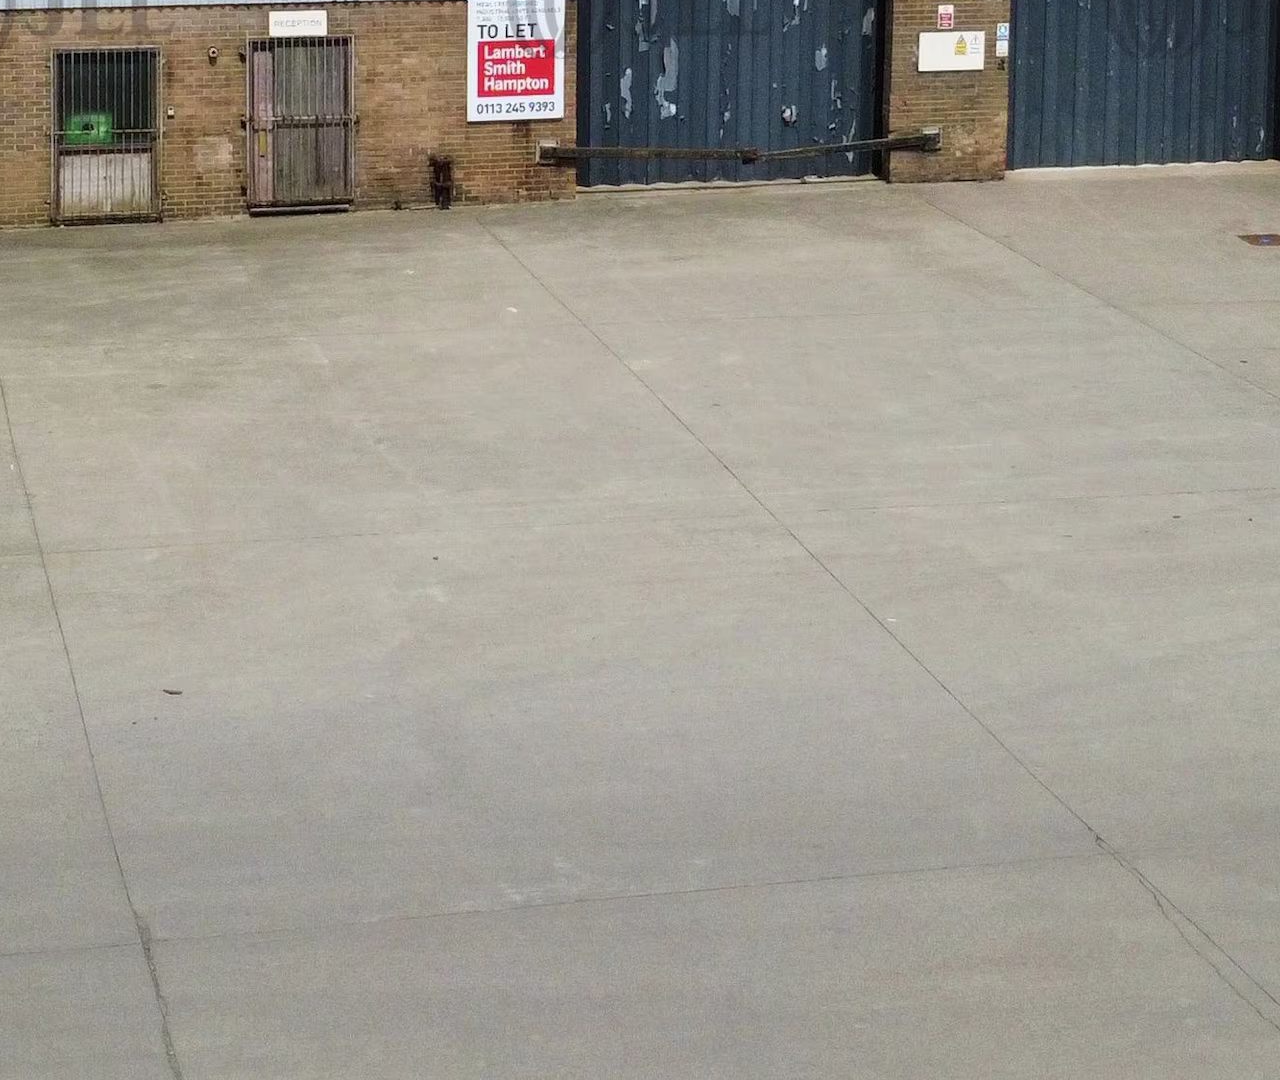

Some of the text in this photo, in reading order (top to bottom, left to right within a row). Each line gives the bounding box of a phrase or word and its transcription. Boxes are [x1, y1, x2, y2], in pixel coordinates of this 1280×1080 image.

[274, 19, 322, 27] RECEPTION
[477, 23, 537, 39] TO LET
[484, 44, 546, 60] Lambert
[483, 60, 526, 76] Smith
[484, 76, 549, 93] Hampton
[477, 101, 555, 114] 0113 245 9393
